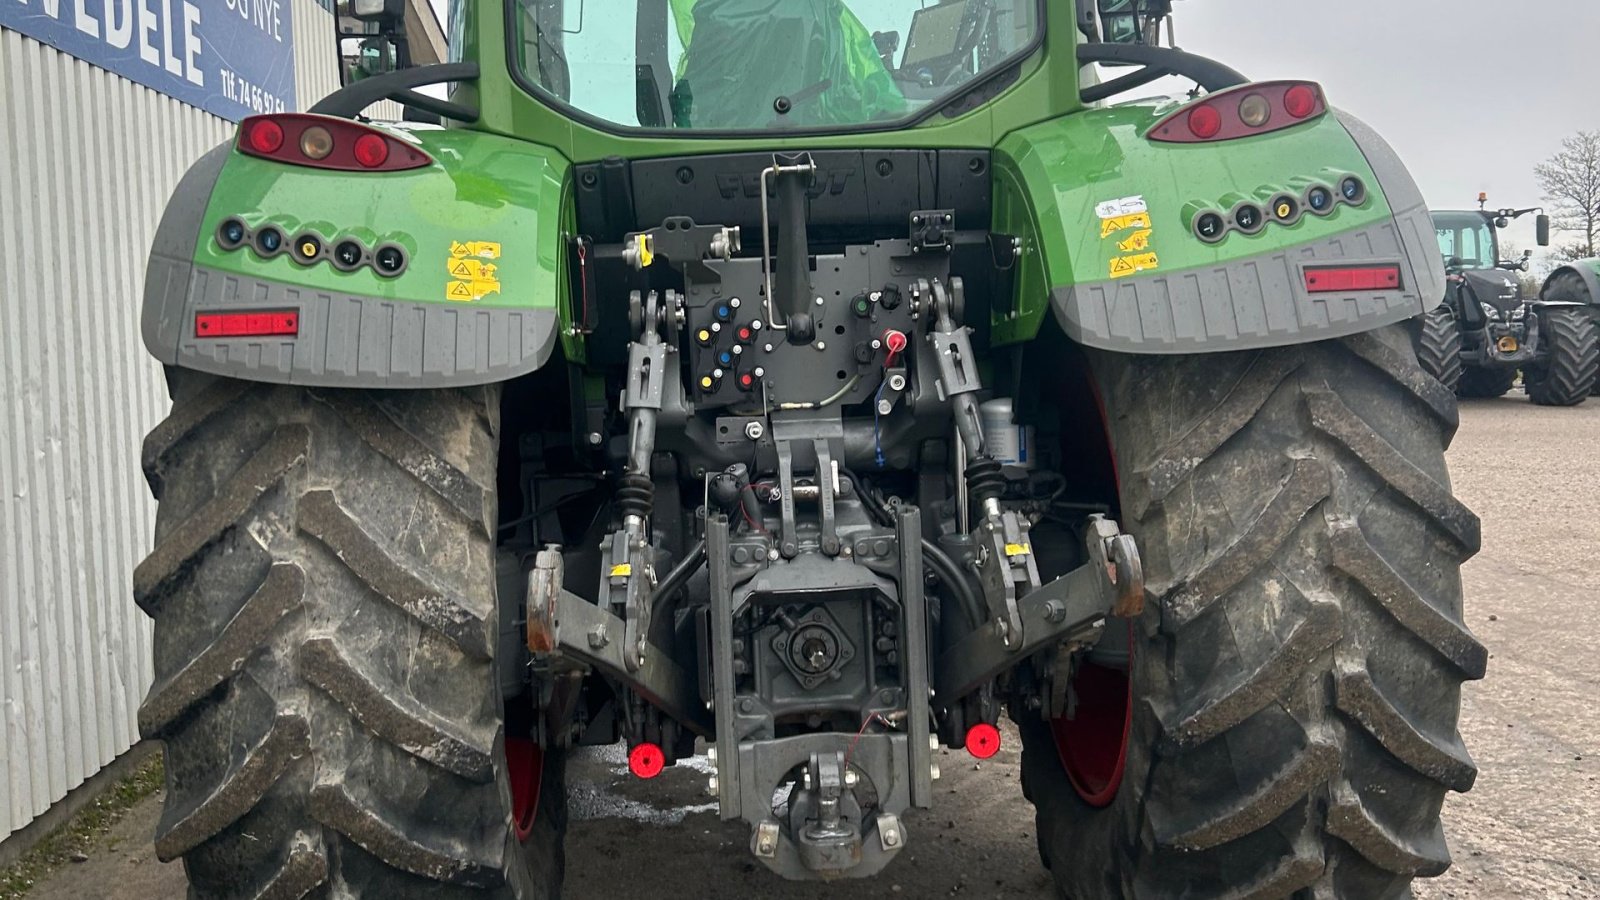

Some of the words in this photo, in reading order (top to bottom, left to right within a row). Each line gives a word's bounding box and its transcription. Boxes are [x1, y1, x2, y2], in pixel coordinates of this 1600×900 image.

[253, 0, 281, 43] NYE
[220, 68, 238, 102] Tlf.
[238, 77, 251, 108] 74
[251, 84, 263, 114] 66
[714, 168, 857, 200] FEDT
